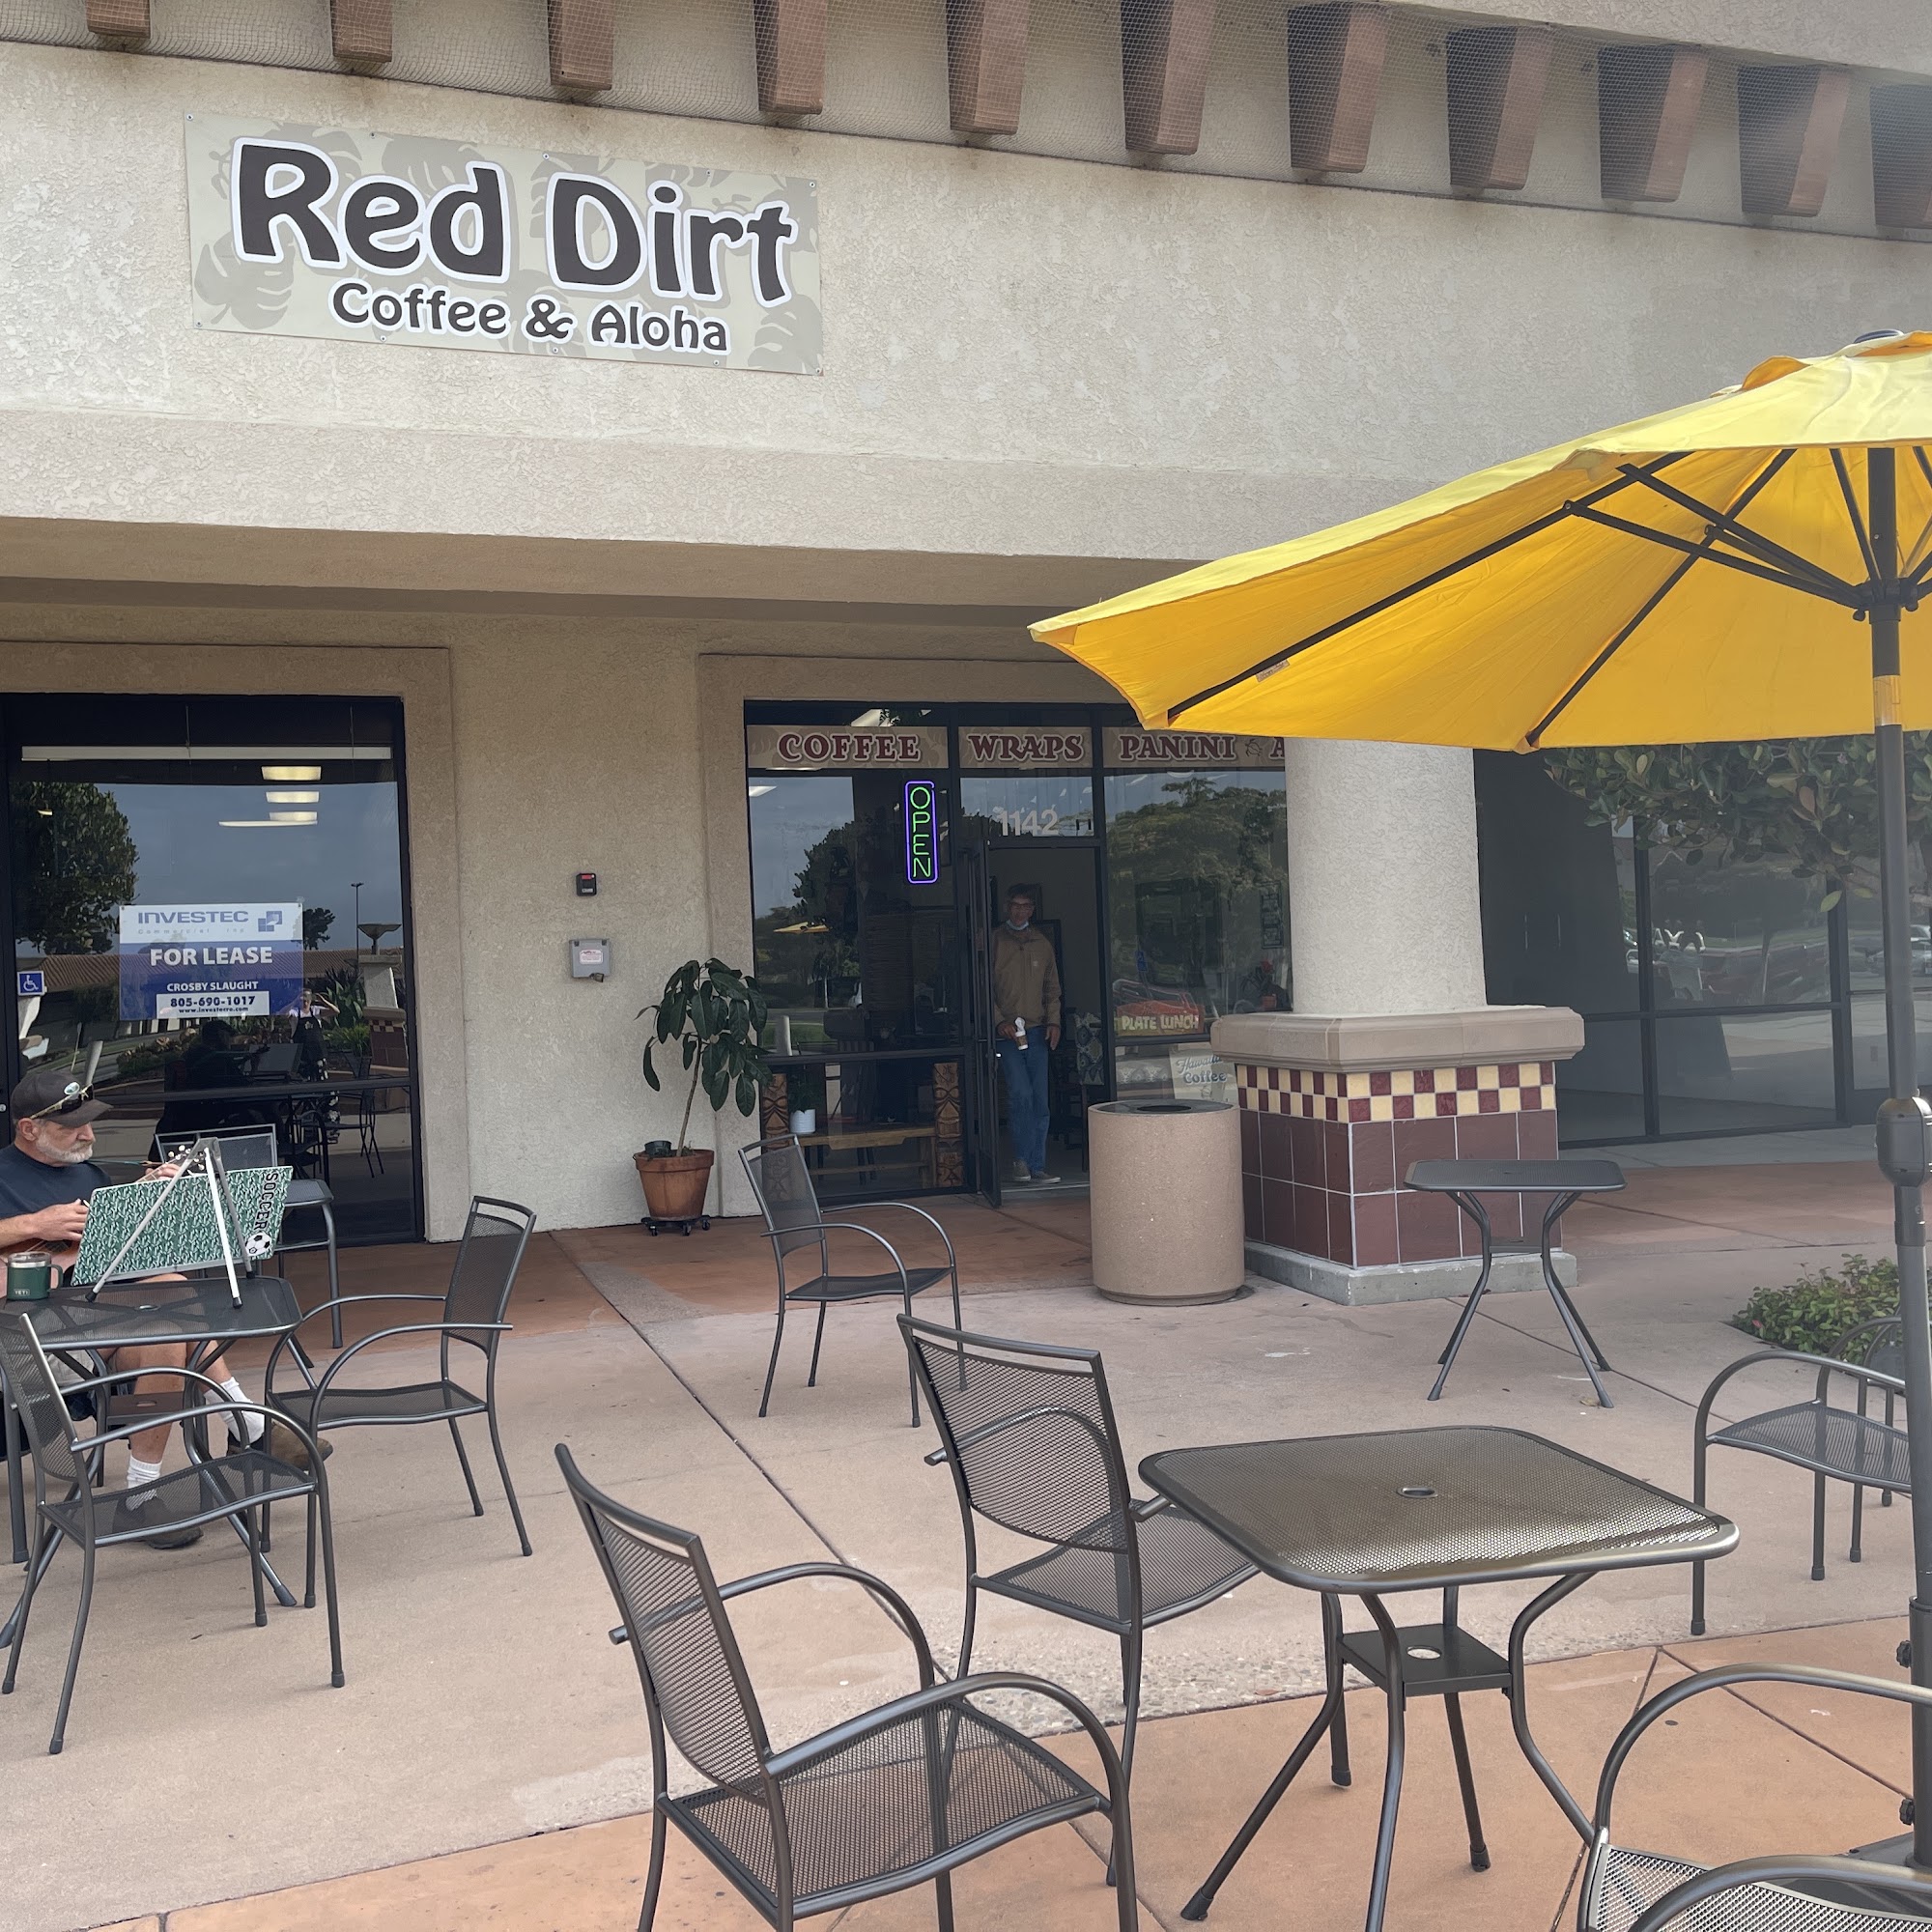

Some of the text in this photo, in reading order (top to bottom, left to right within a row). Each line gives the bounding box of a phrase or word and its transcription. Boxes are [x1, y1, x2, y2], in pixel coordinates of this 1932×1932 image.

[237, 141, 794, 303] Red Dirt
[331, 281, 729, 352] Coffee & Aloha
[778, 732, 921, 761] COFFEE
[967, 735, 1083, 760] WRAPS
[1118, 735, 1236, 760] PANINI
[909, 785, 932, 879] OPEN
[998, 809, 1059, 837] 1142
[138, 911, 249, 924] INVESTEC
[150, 946, 273, 966] FOR LEASE
[166, 980, 259, 992] CROSBY SLAUGHT
[170, 995, 256, 1008] 805-690-1017
[1122, 1013, 1200, 1031] PLATE LUNCH
[1183, 1070, 1227, 1085] Coffee
[253, 1173, 279, 1231] SOCCER
